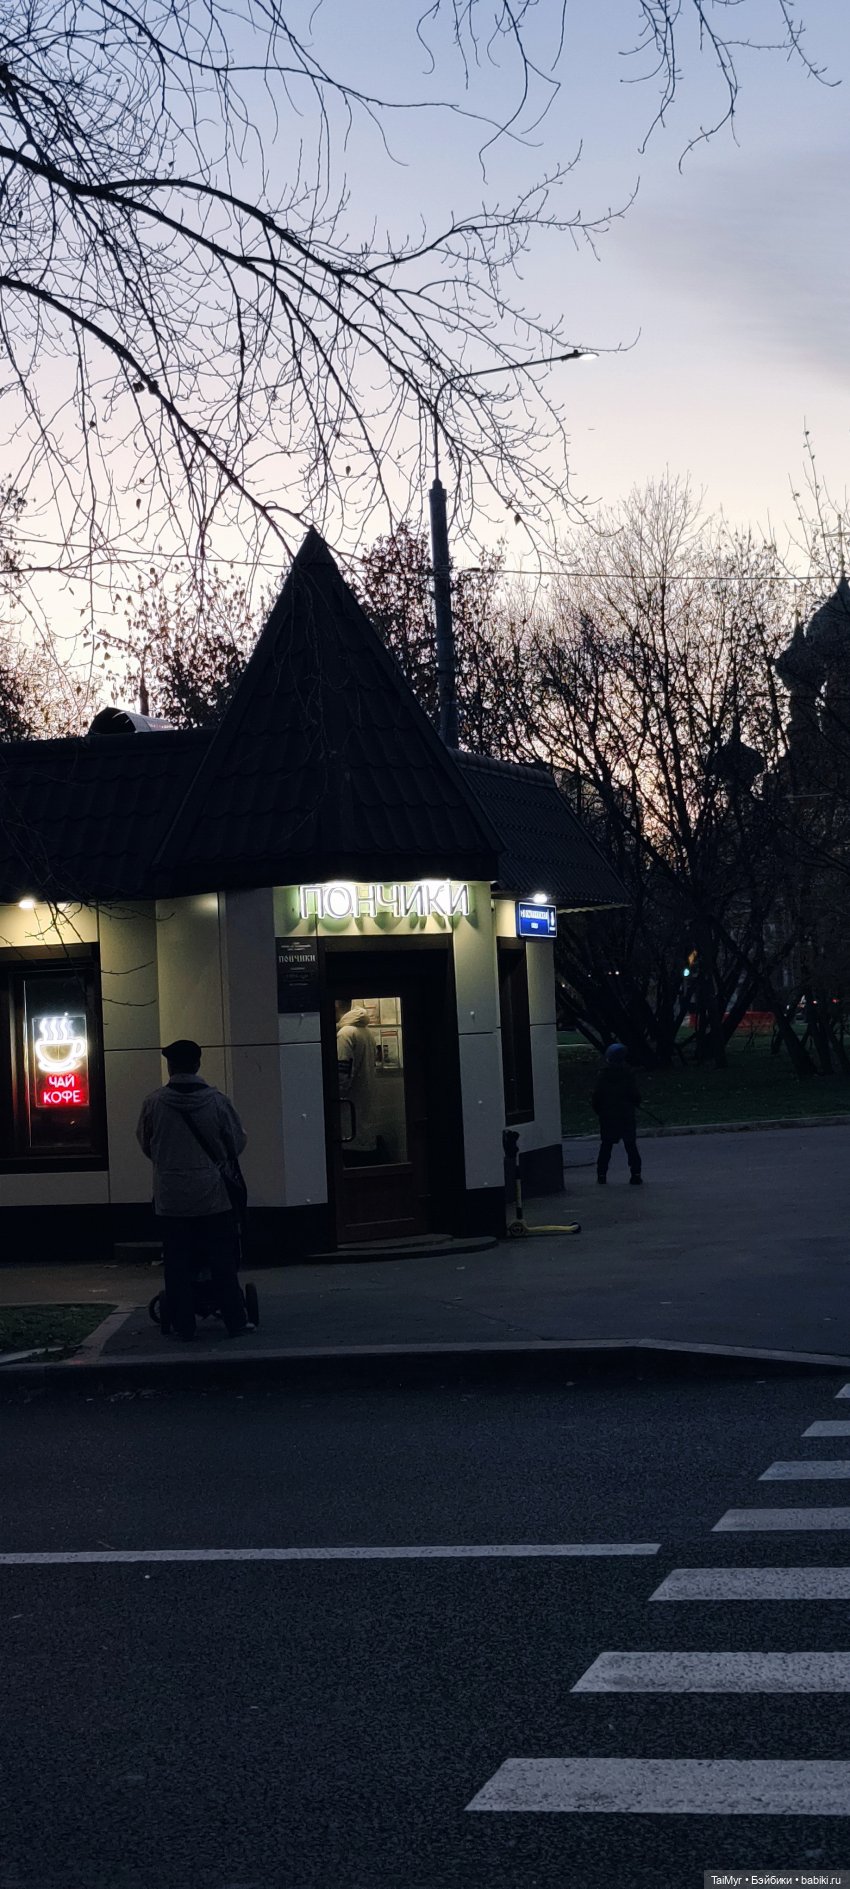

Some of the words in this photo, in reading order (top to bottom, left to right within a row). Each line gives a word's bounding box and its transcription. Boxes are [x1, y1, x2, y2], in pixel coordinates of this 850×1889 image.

[300, 884, 469, 919] ПОНЧИКИ
[48, 1073, 75, 1088] ЧАЙ
[43, 1090, 81, 1104] КОФЕ
